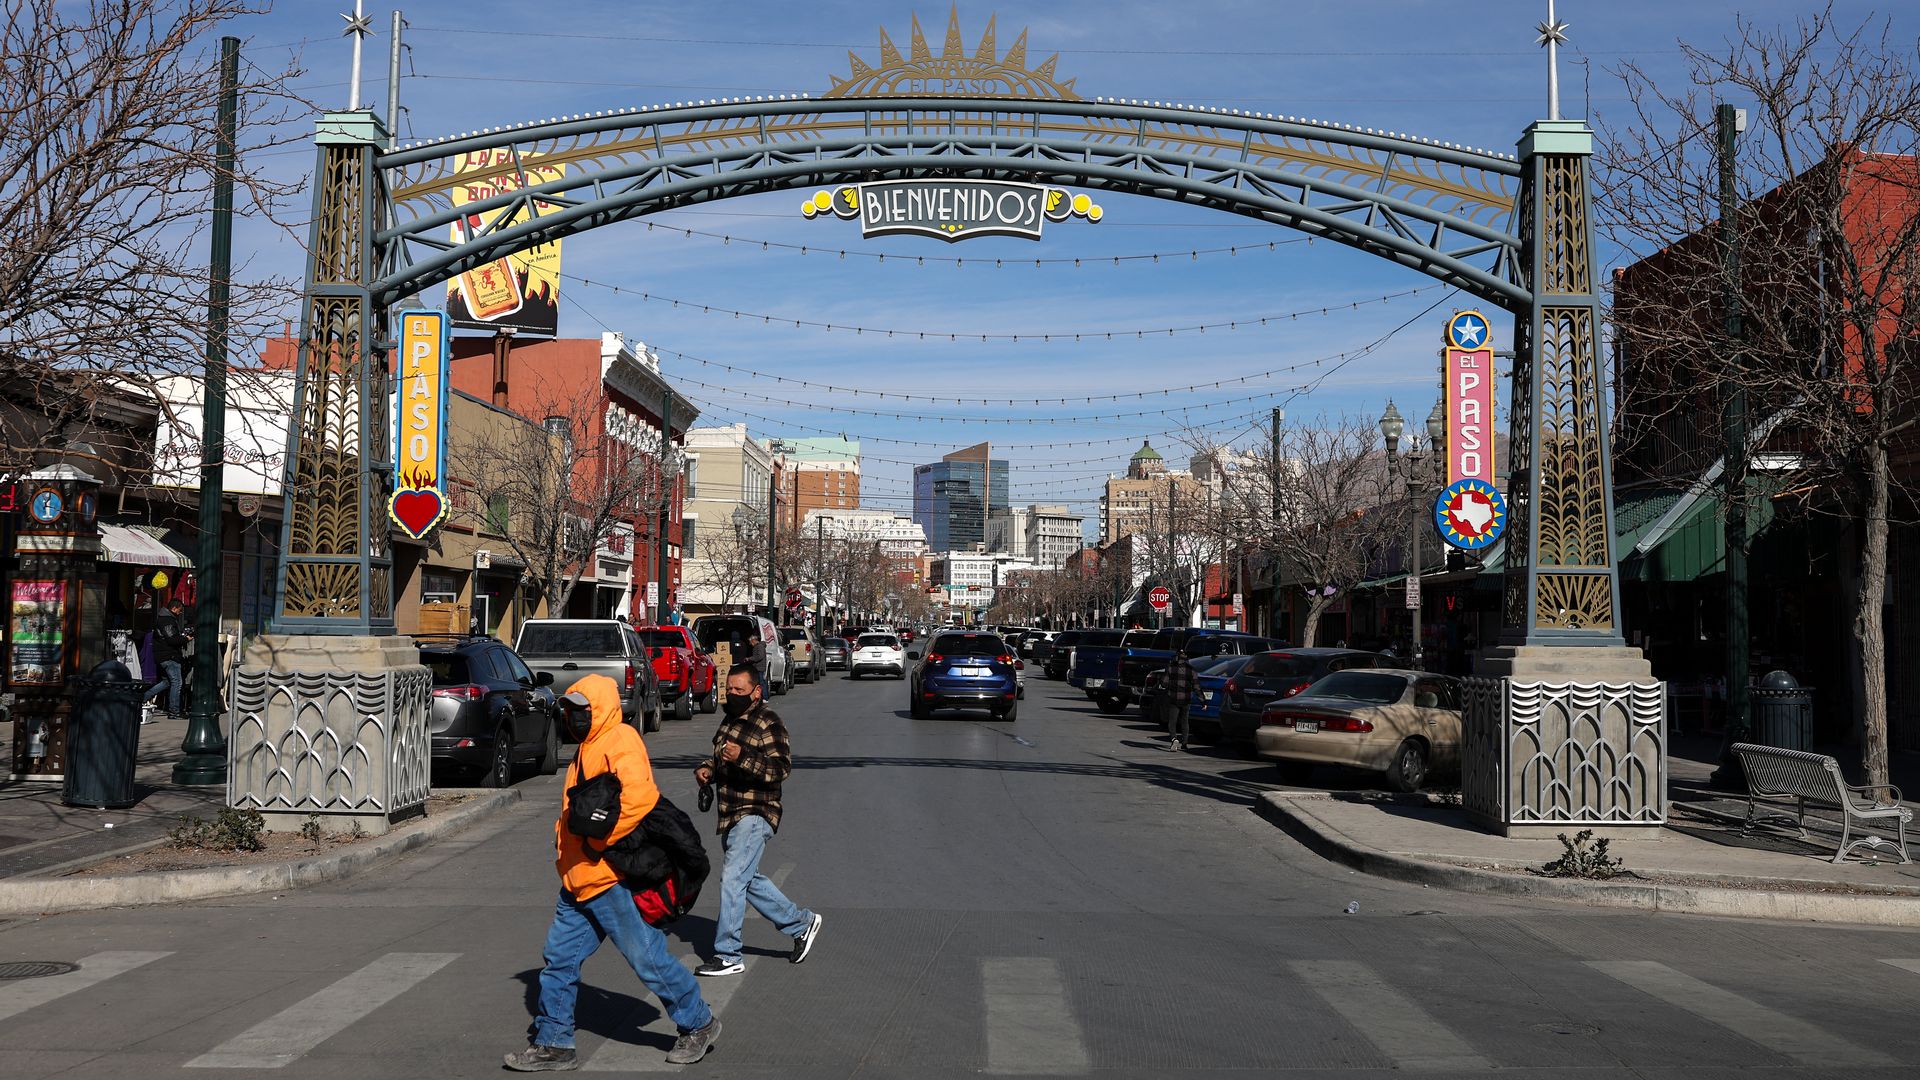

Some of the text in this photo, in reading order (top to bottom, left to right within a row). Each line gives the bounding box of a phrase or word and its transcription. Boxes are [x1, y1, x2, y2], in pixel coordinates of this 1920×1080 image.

[910, 78, 997, 95] EL PASO
[866, 188, 1038, 226] BIENVENIDOS
[409, 320, 432, 462] EL PASO
[1459, 355, 1481, 477] EL PASO
[1150, 593, 1170, 602] STOP
